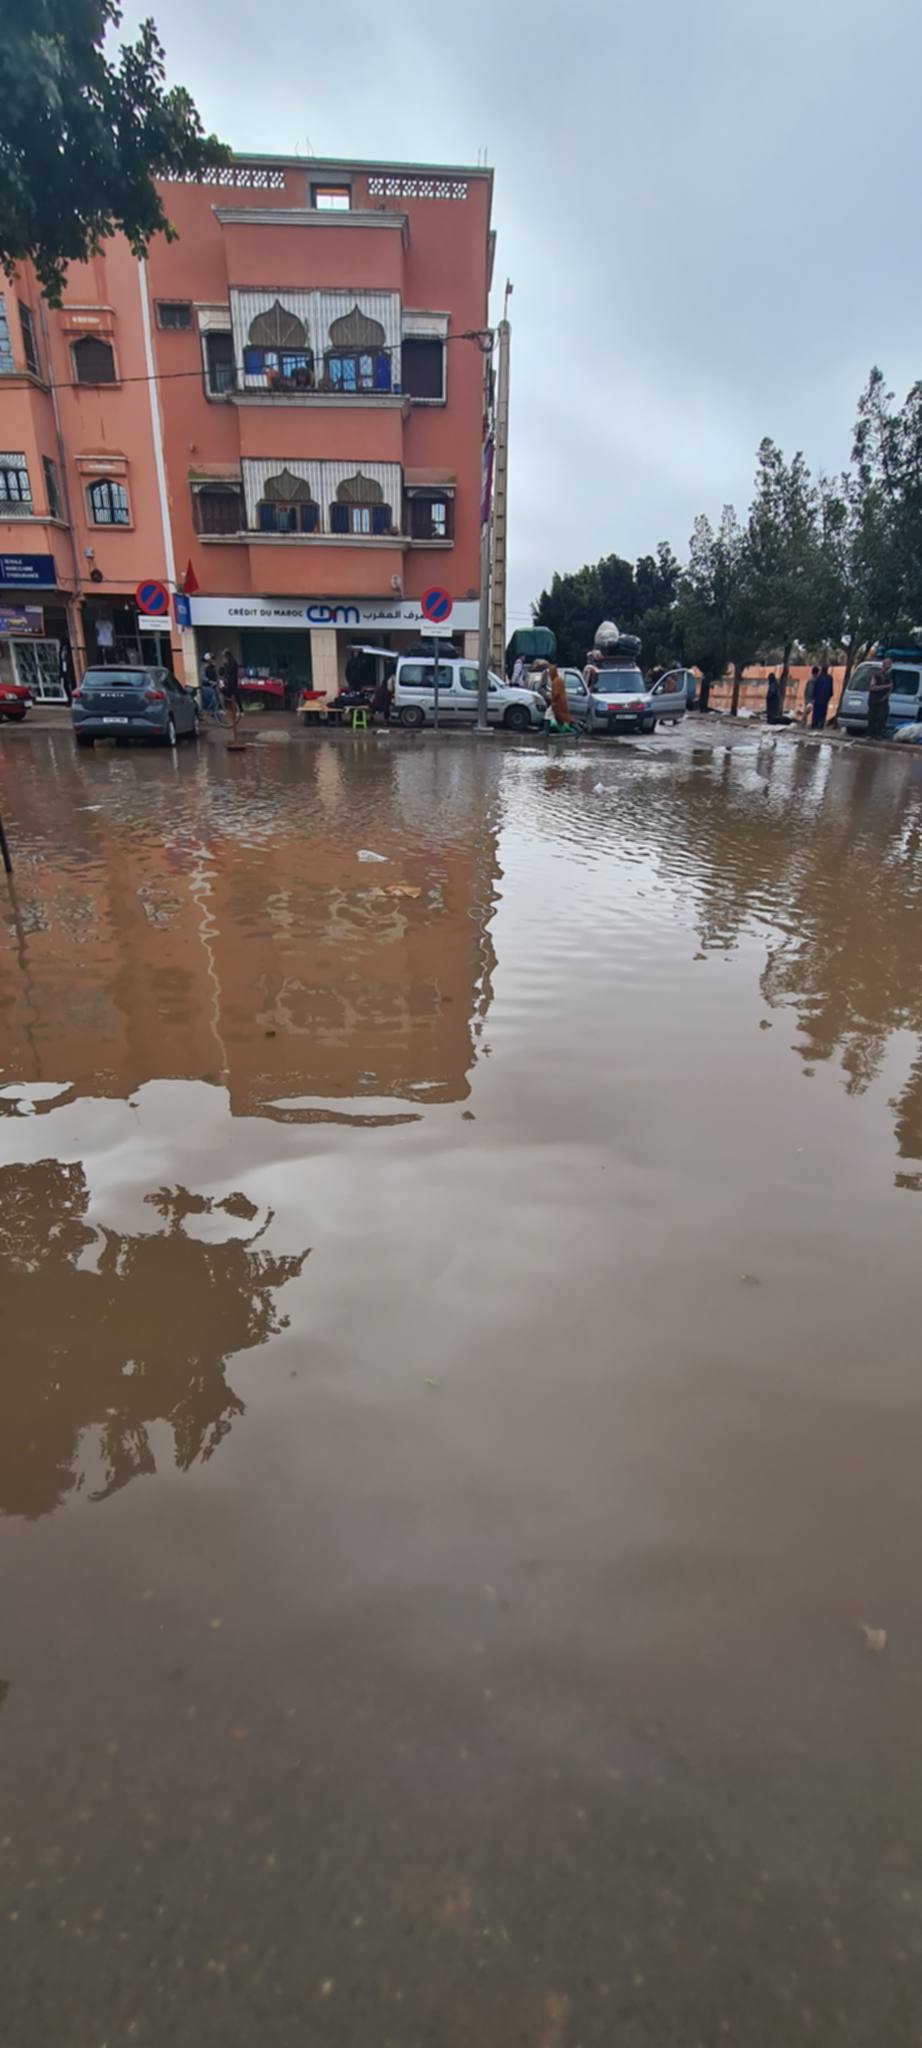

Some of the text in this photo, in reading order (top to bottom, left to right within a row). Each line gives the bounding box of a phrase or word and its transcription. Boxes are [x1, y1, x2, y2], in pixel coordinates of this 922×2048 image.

[228, 607, 304, 617] CRÉDIT DU MAROC
[362, 610, 402, 621] المغرب
